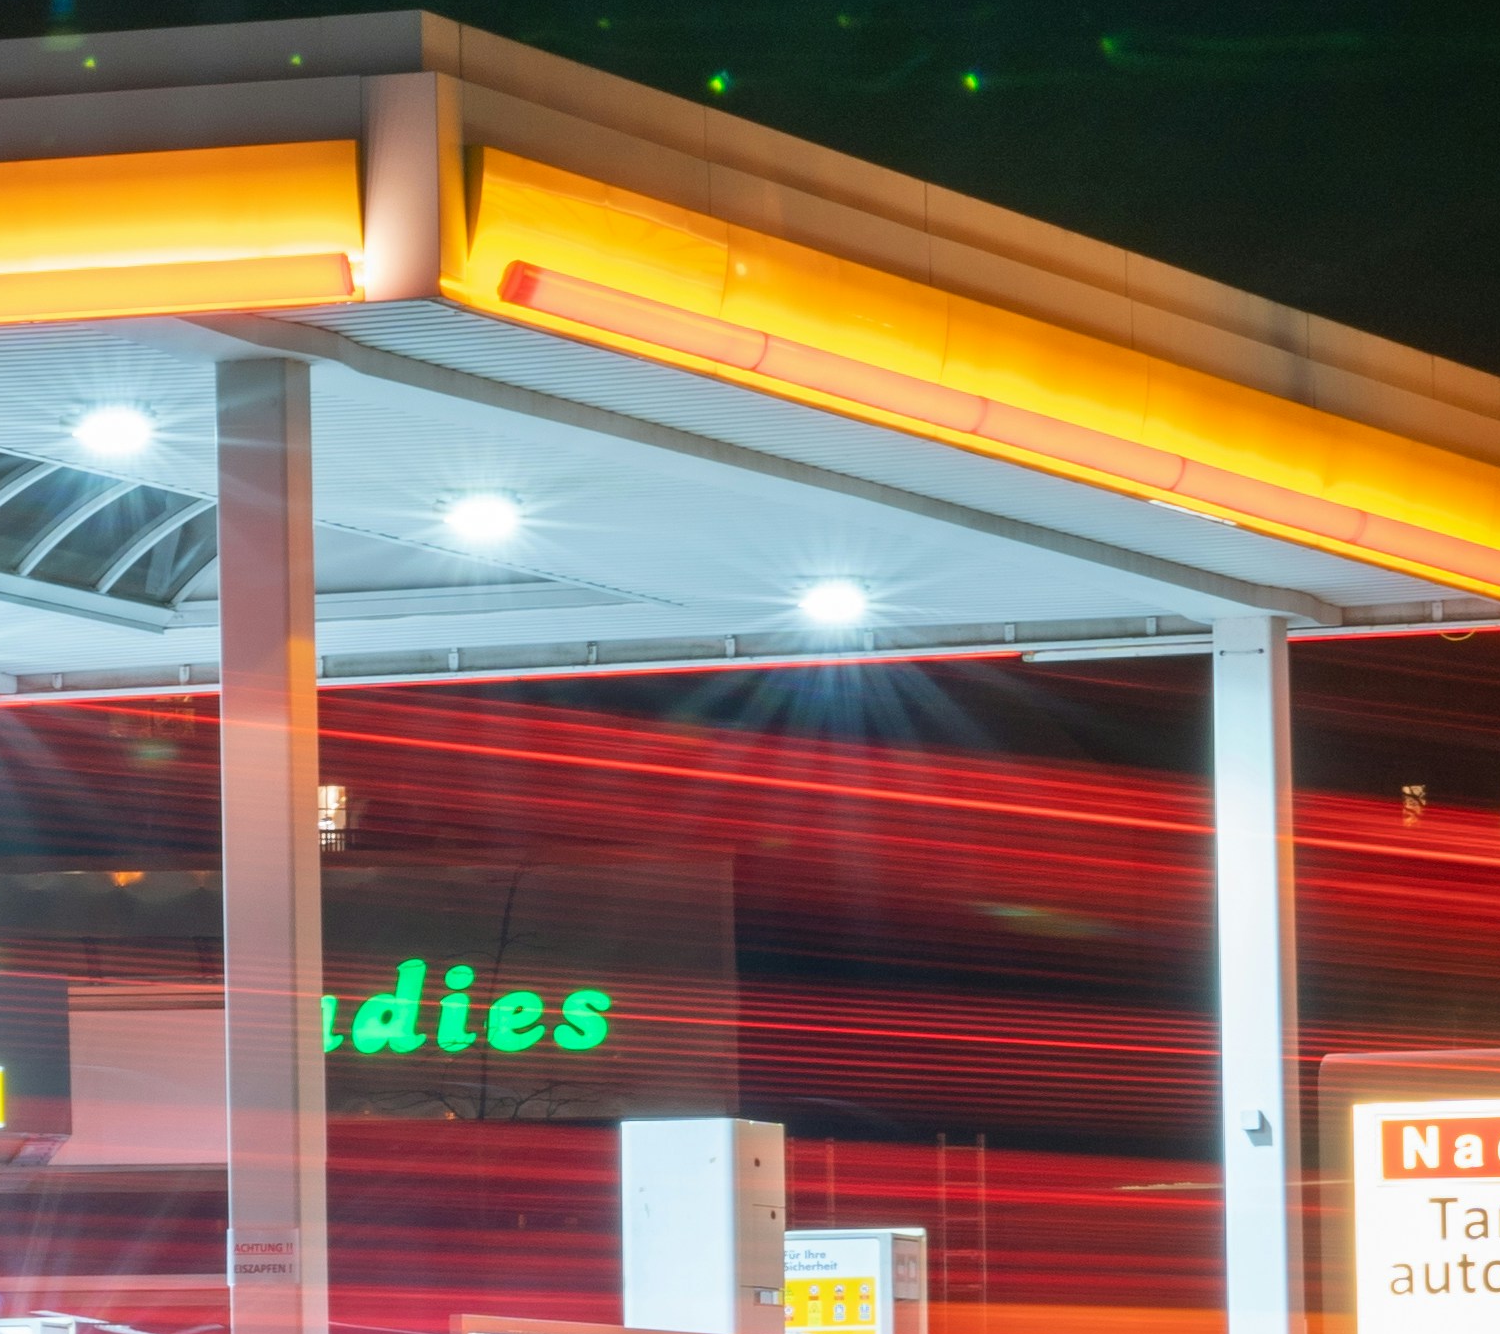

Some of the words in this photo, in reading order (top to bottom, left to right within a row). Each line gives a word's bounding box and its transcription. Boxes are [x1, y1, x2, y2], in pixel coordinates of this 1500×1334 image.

[234, 1242, 283, 1253] ACHTUNG
[804, 1249, 826, 1259] Ihre
[234, 1263, 286, 1274] EISZAPFEN
